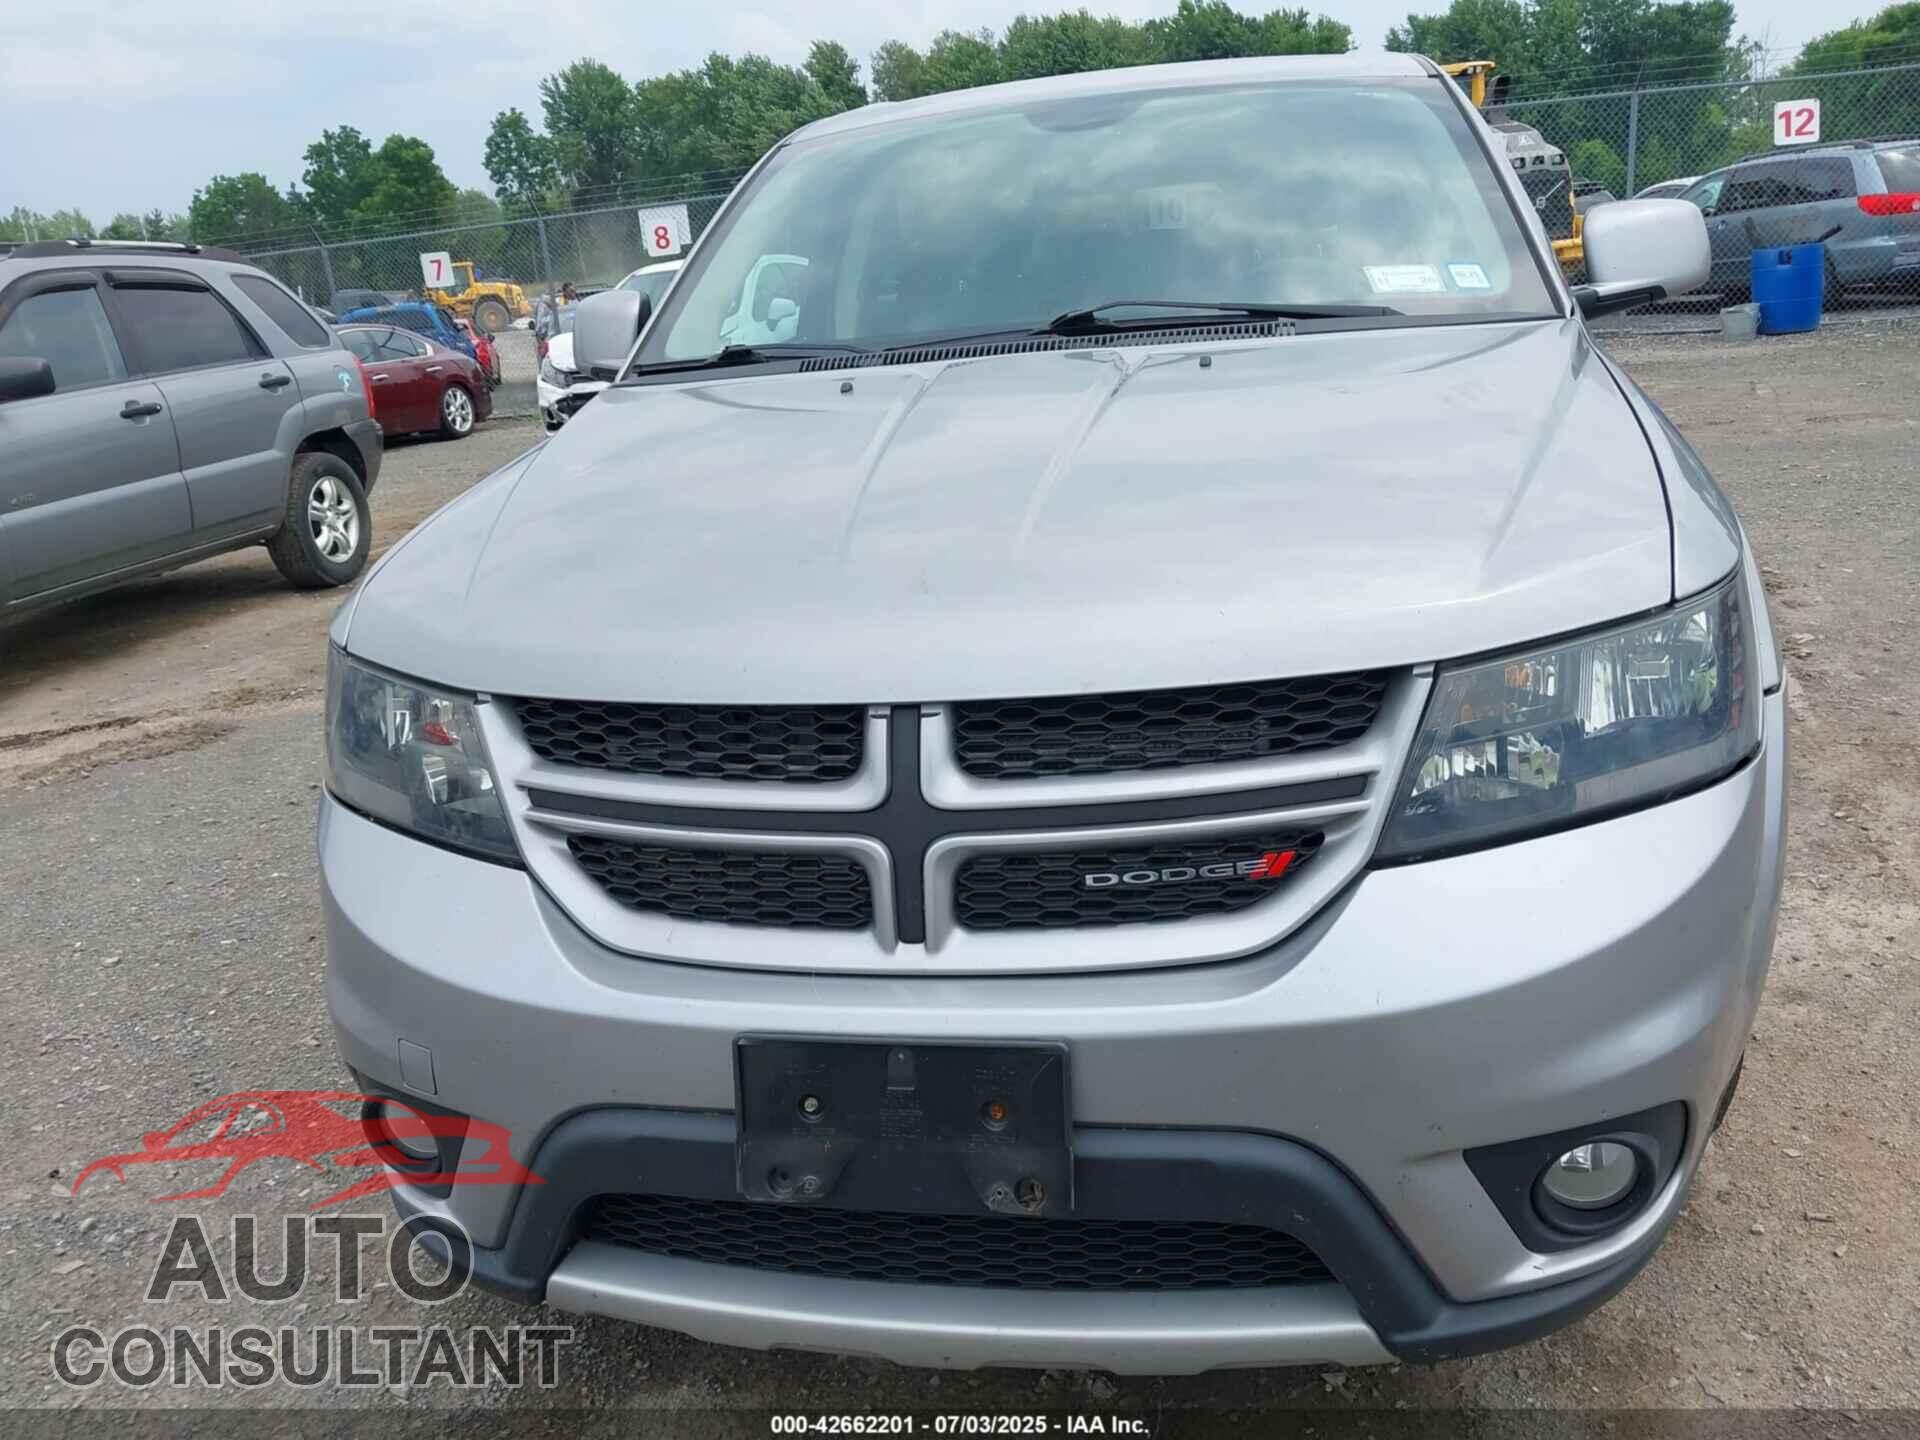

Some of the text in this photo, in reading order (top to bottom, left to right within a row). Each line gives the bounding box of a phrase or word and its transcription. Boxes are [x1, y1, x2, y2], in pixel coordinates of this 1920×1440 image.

[1778, 108, 1815, 137] 12
[654, 226, 670, 250] 8
[429, 259, 442, 281] 7
[1084, 859, 1268, 888] DODGE
